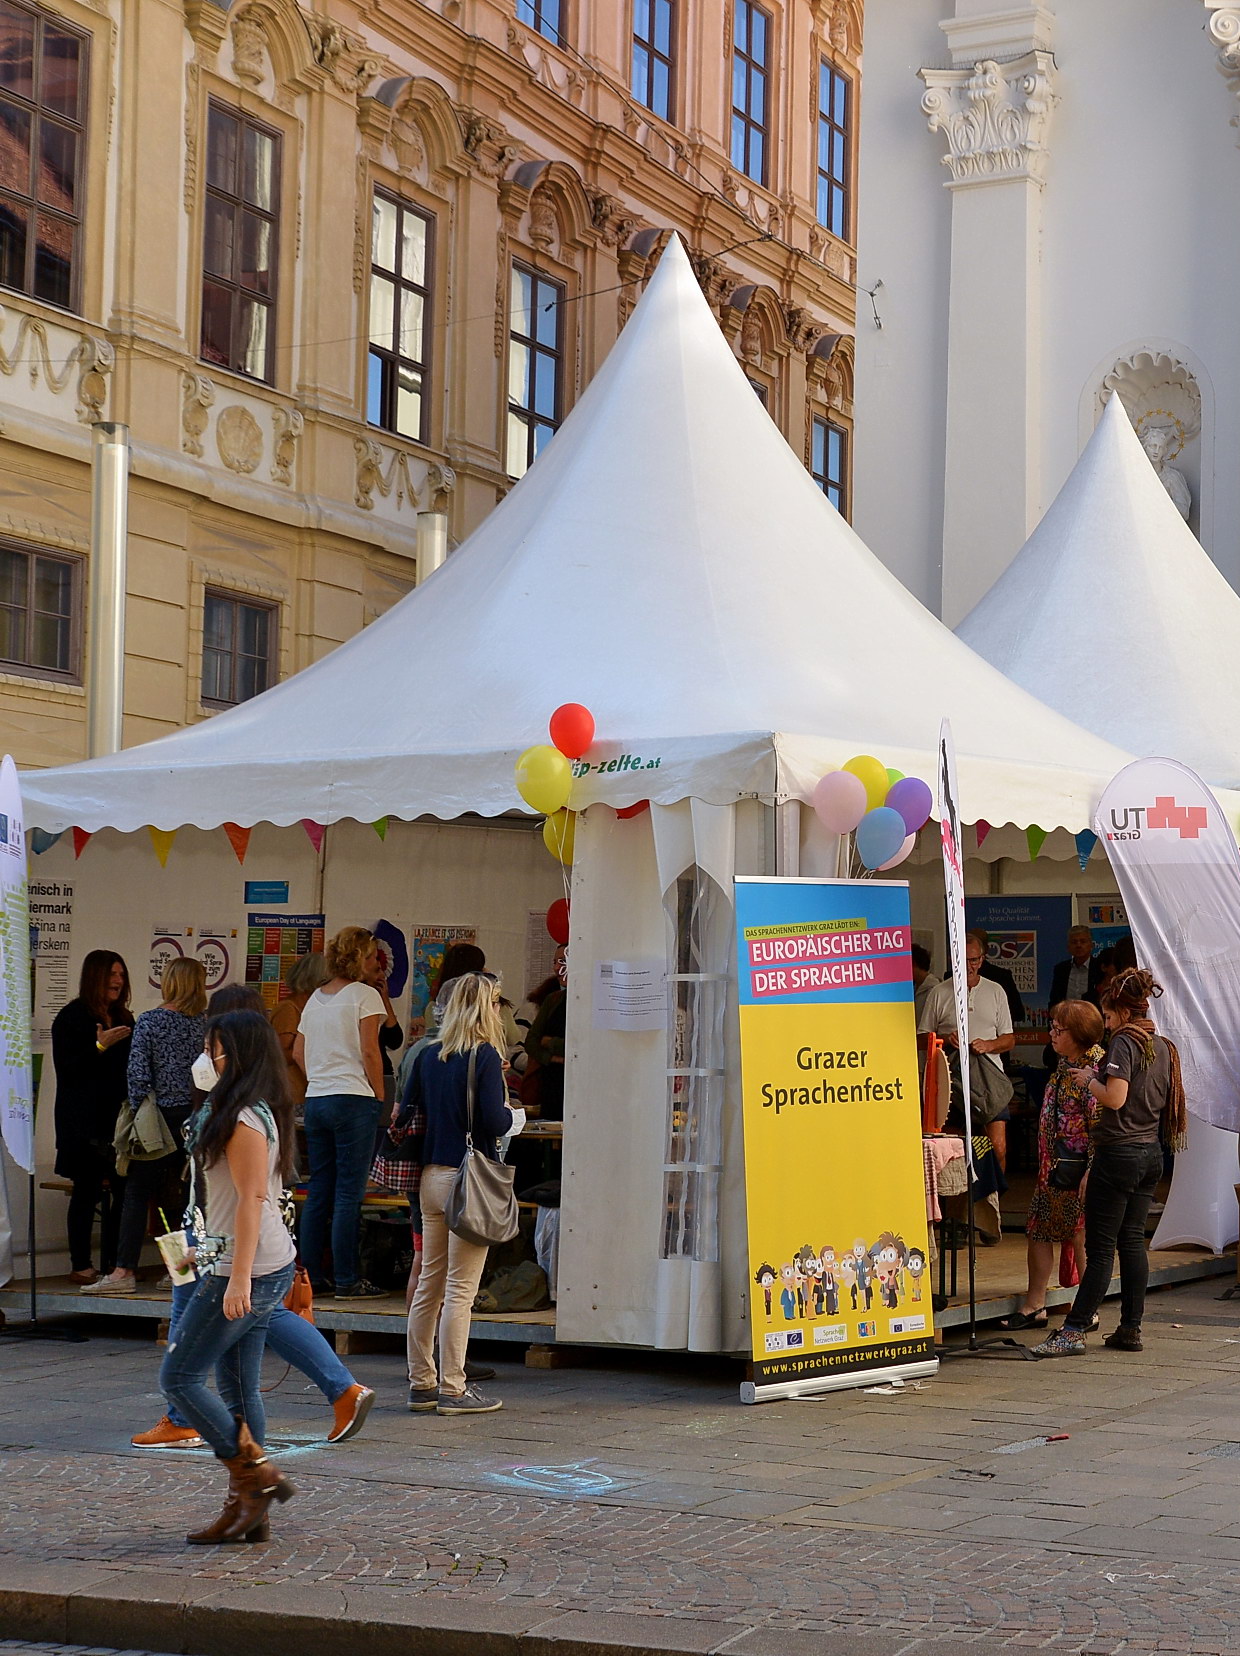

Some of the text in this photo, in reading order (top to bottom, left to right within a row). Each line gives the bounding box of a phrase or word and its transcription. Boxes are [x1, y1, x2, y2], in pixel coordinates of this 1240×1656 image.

[63, 884, 73, 897] in
[29, 900, 72, 914] iermark
[29, 917, 71, 933] ščina na
[255, 916, 279, 924] European
[295, 917, 321, 925] Languages
[745, 920, 861, 938] DAS SPRACHENNETZWERK GRAZ LÄDT EIN:
[30, 937, 70, 952] jerskem
[752, 931, 904, 962] EUROPÄISCHER TAG
[755, 962, 875, 993] DER SPRACHEN
[796, 1046, 868, 1071] Grazer
[761, 1076, 904, 1115] Sprachenfest
[762, 1341, 928, 1375] www.sprachennetzwerkgraz.at
